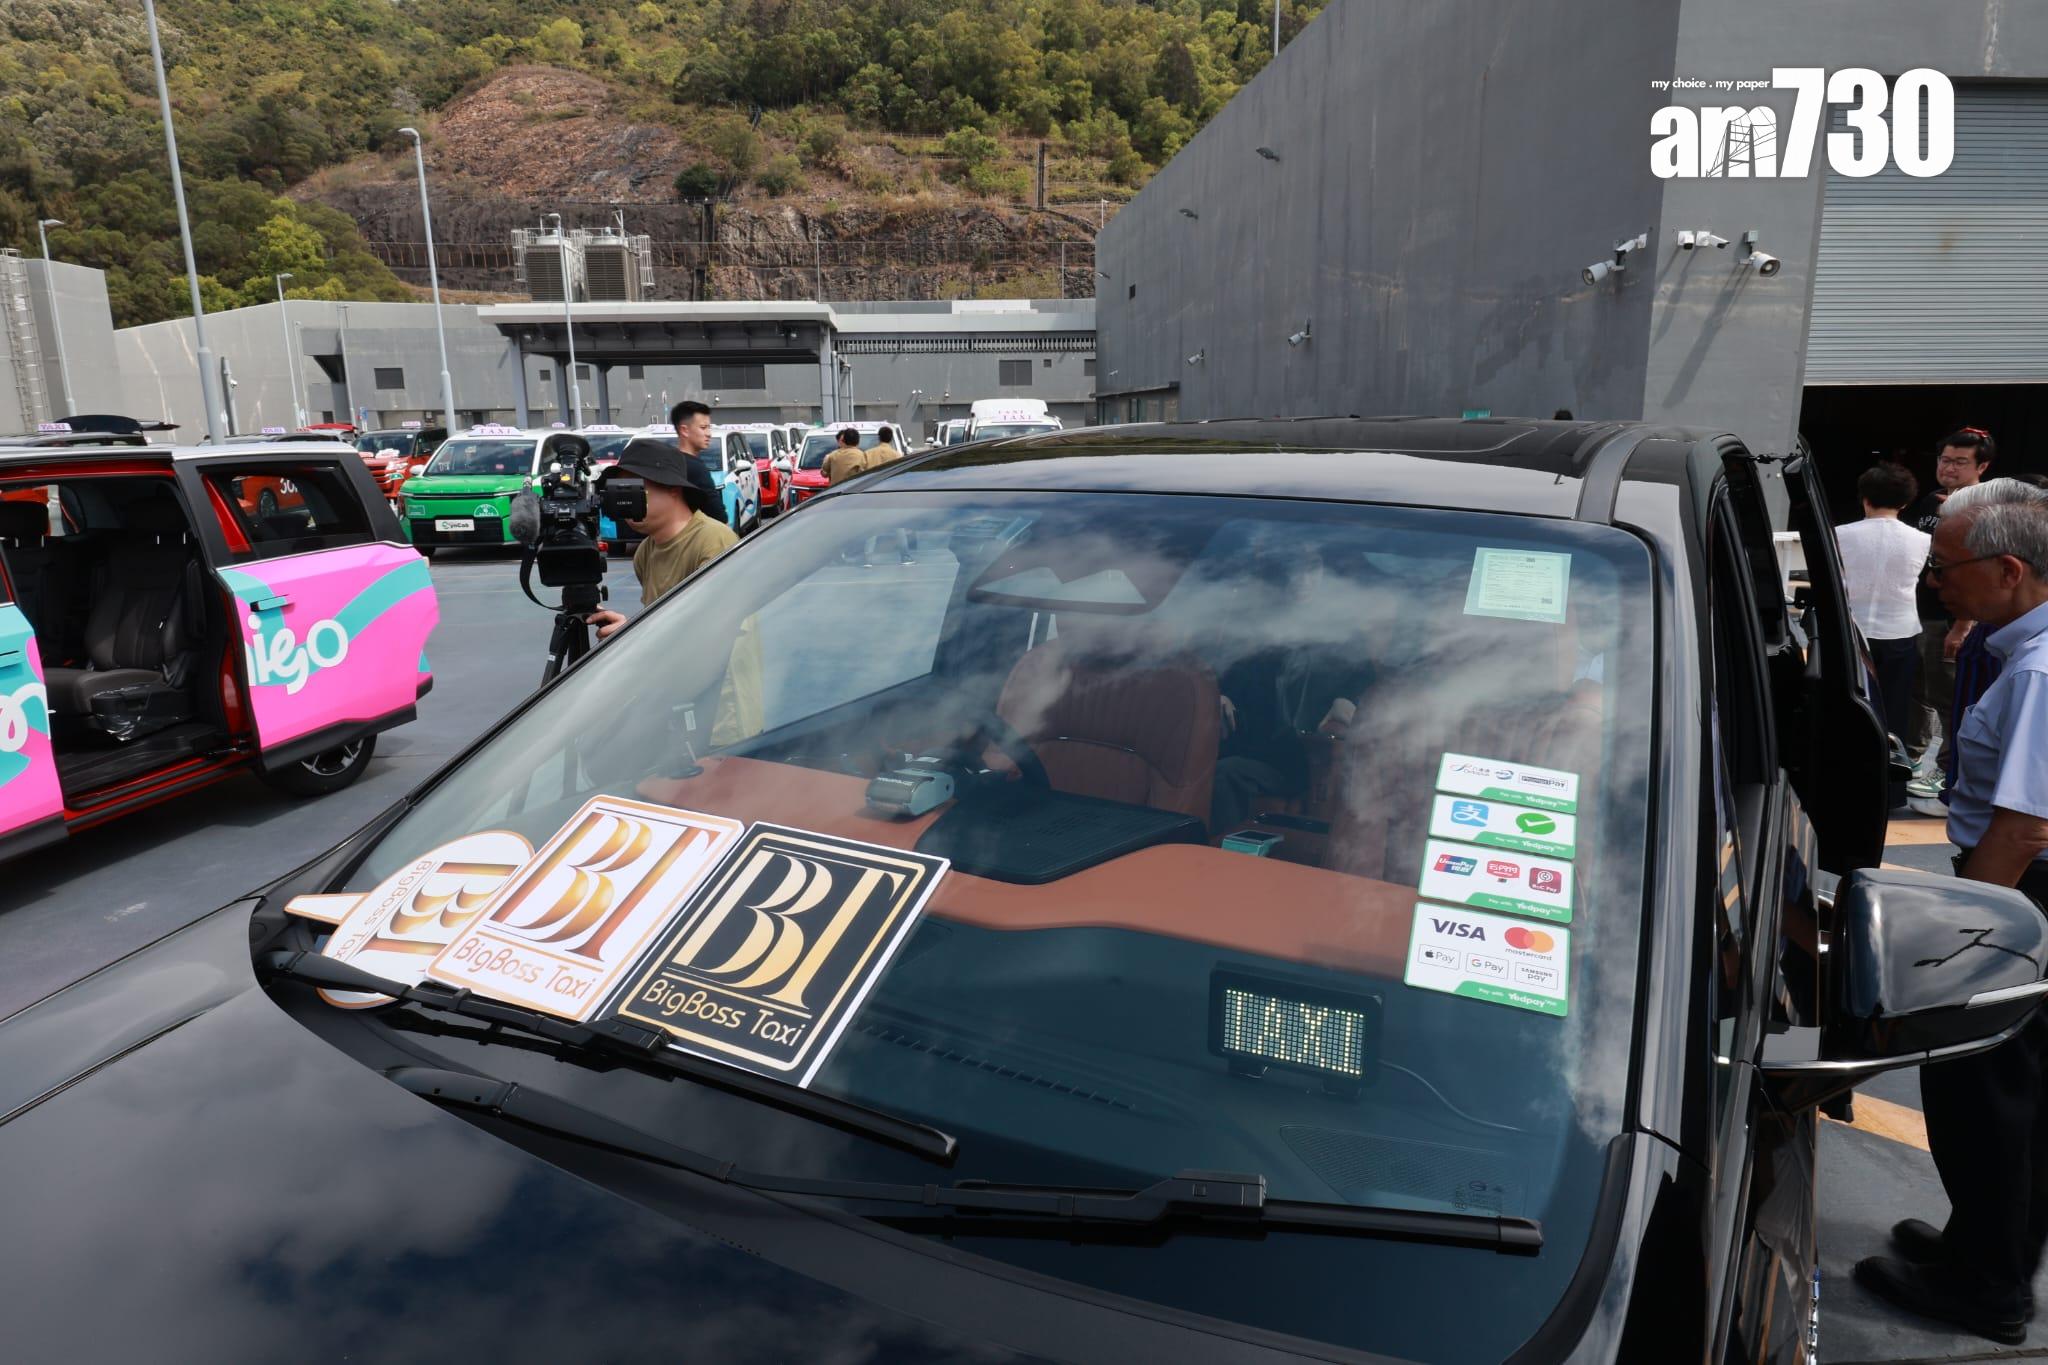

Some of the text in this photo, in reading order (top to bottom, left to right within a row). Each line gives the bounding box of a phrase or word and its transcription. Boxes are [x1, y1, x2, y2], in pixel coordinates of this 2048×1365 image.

[365, 859, 433, 926] BigBoss
[1428, 917, 1486, 942] VISA
[1436, 951, 1455, 964] Pay
[1505, 947, 1552, 961] mastercard
[452, 937, 597, 1000] BigBoss Taxi
[1485, 961, 1504, 974] Pay
[1521, 967, 1553, 977] SAMSUNG
[1527, 974, 1546, 983] pay
[1508, 992, 1546, 1008] Yedpay
[641, 979, 807, 1047] BigBoss Taxi
[1226, 989, 1364, 1075] TAXI
